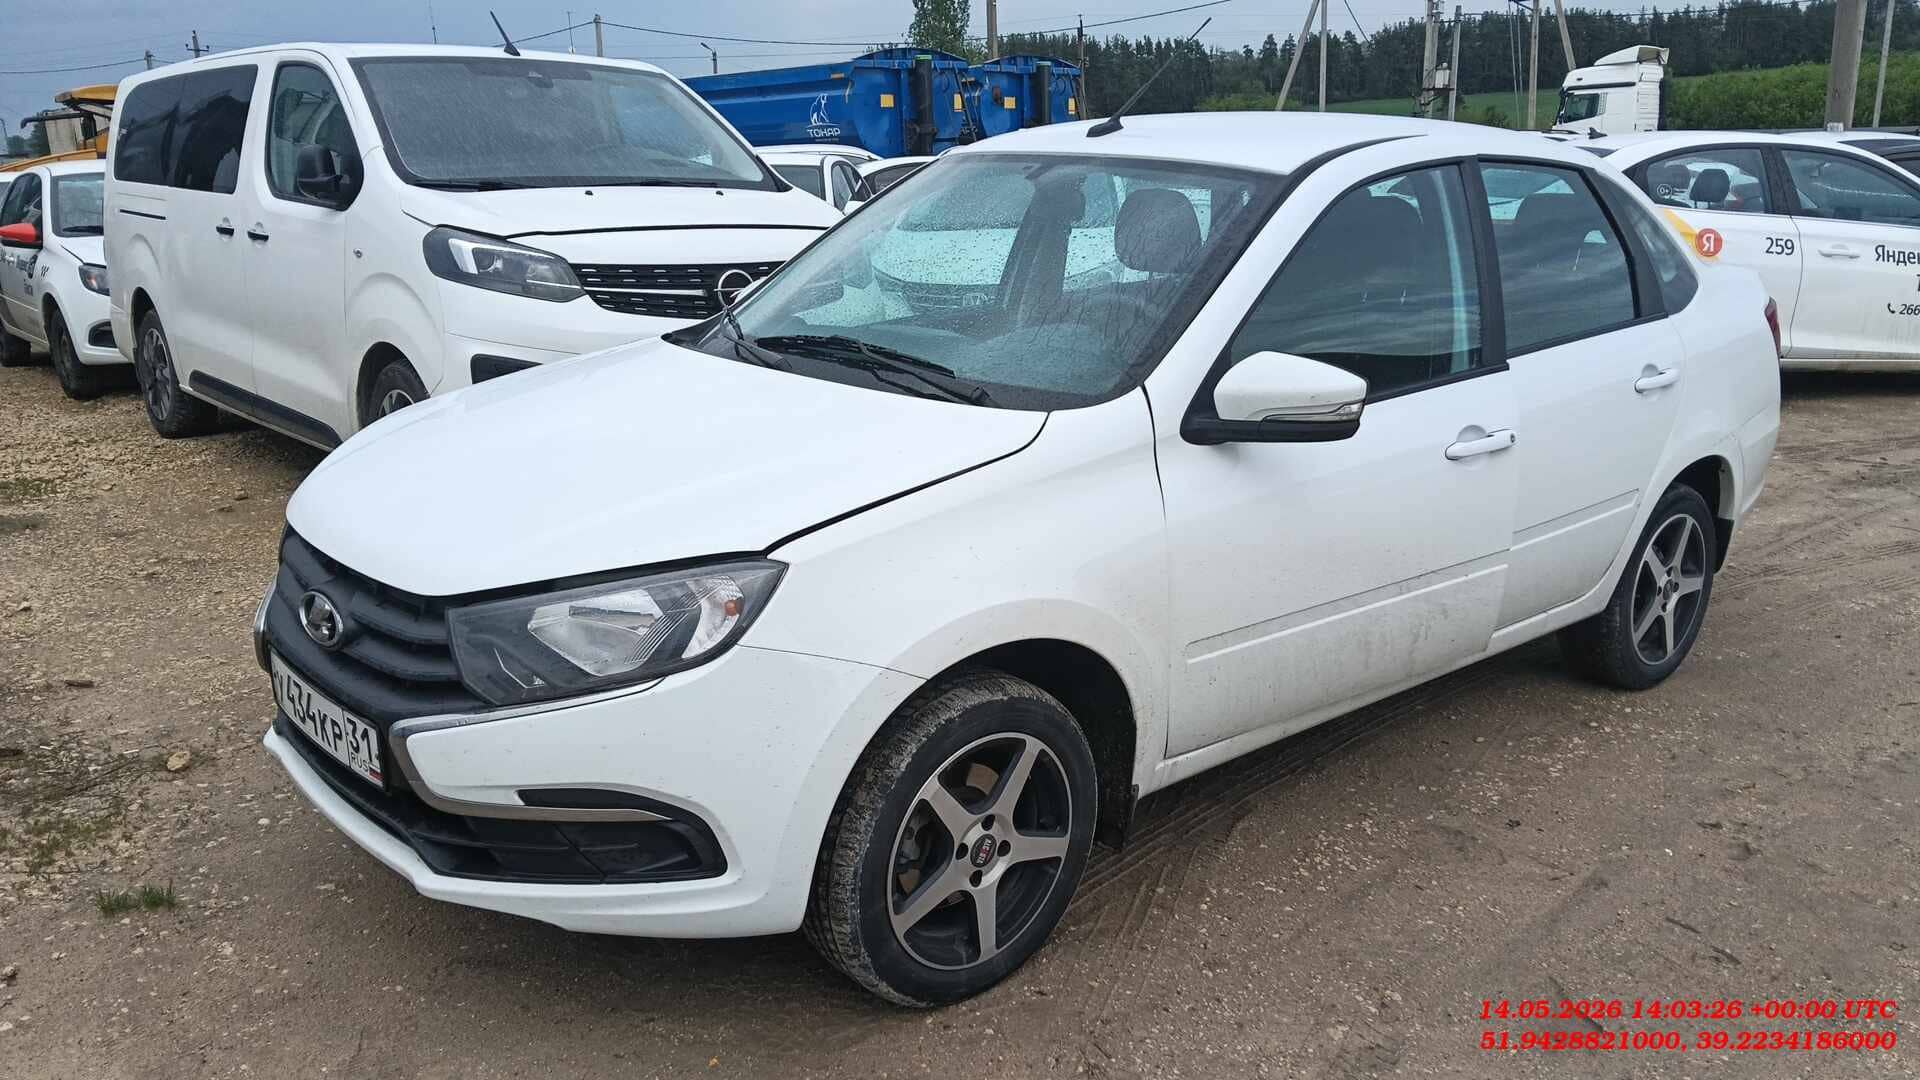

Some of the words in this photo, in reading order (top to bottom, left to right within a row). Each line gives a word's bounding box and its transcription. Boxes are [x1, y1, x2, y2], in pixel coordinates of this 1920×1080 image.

[807, 127, 841, 137] ТОНАР
[1701, 233, 1716, 252] Я
[1765, 237, 1795, 256] 259
[346, 717, 374, 763] 31
[350, 751, 370, 773] RUS
